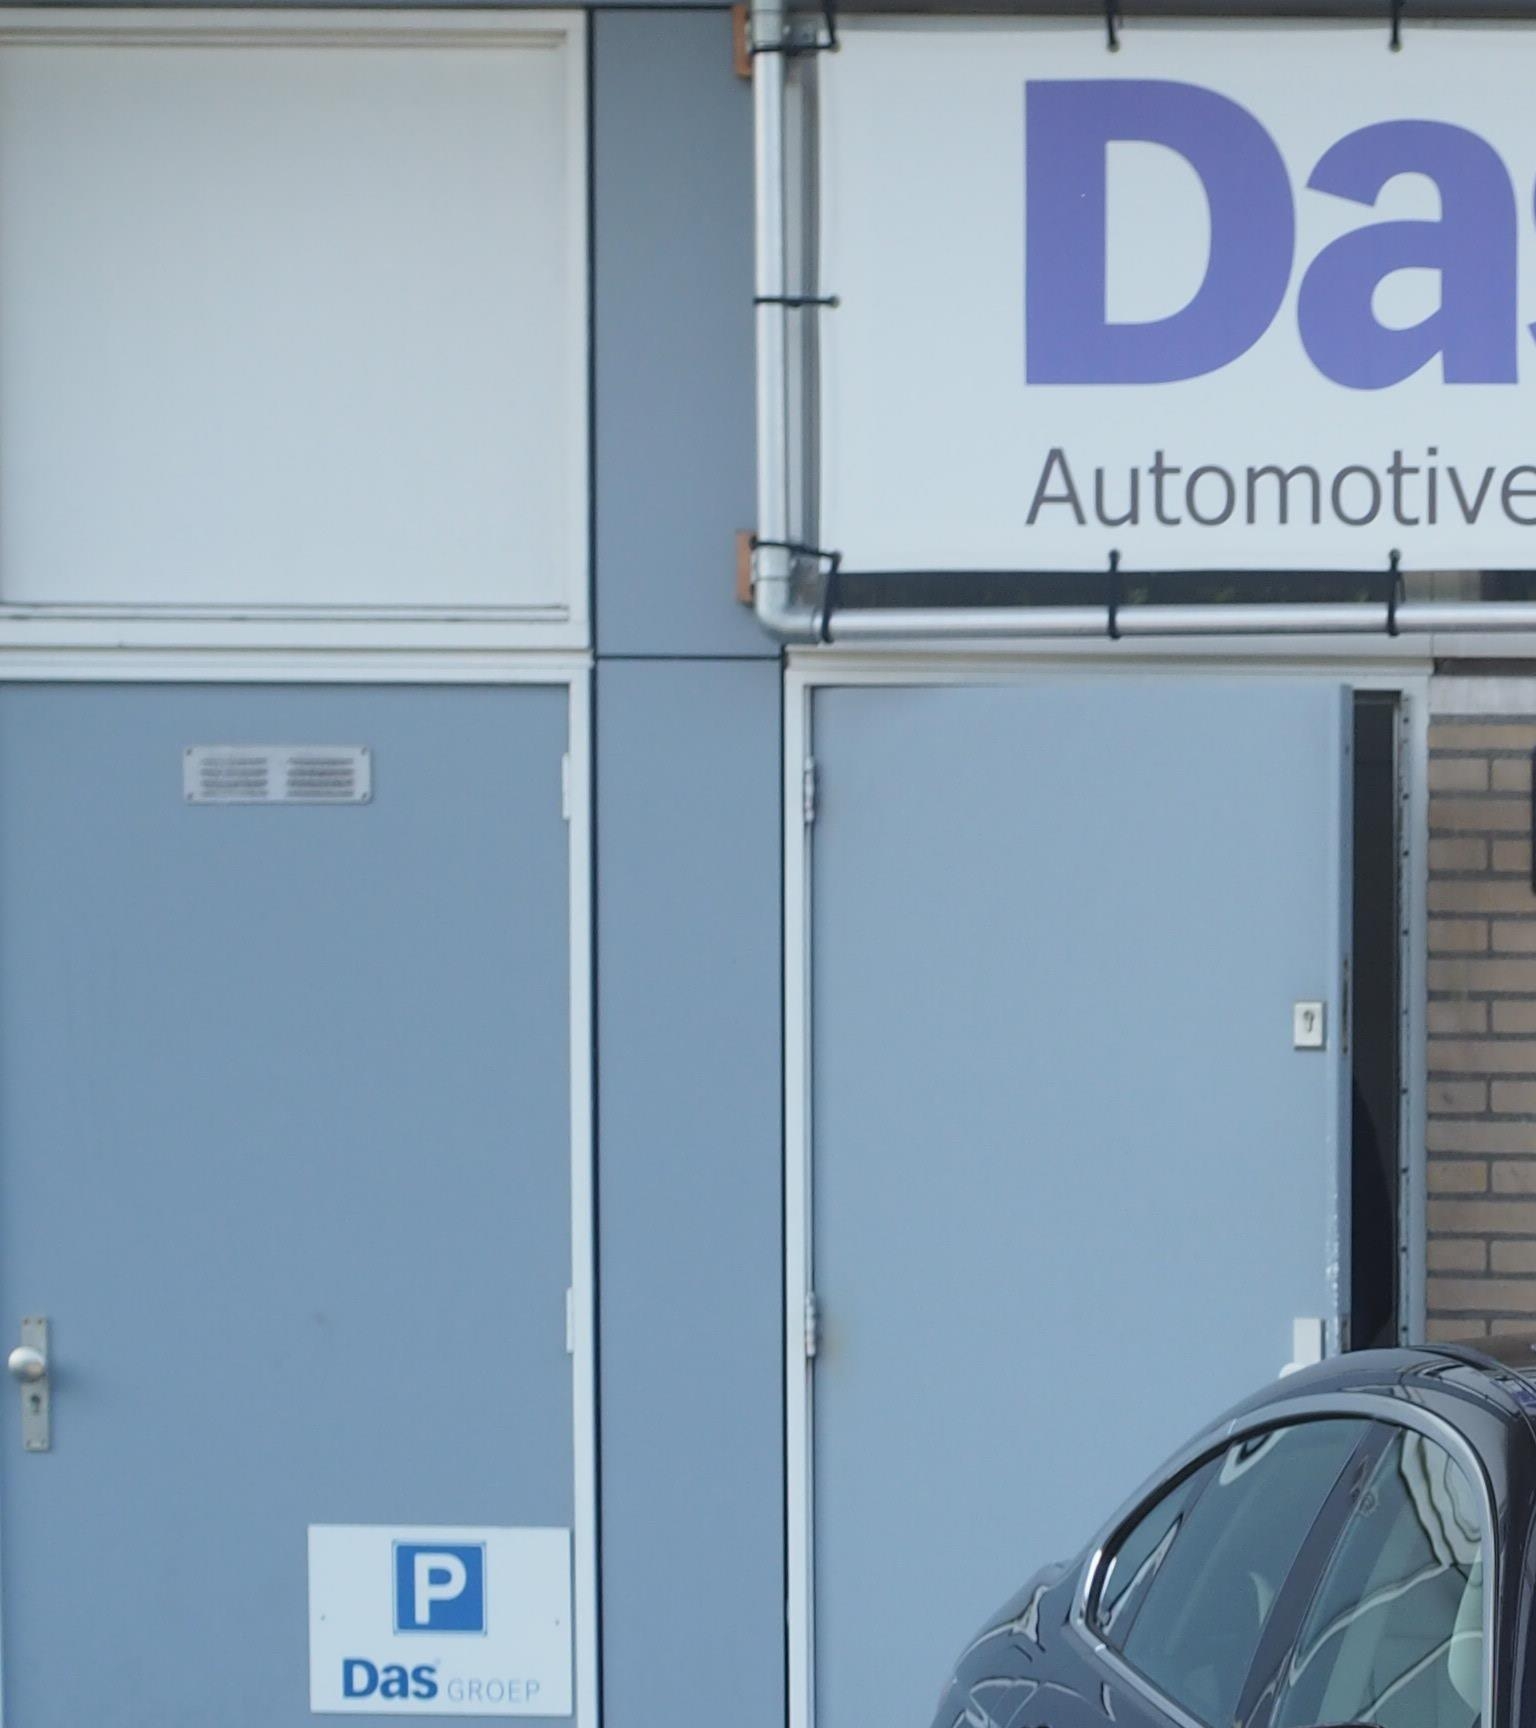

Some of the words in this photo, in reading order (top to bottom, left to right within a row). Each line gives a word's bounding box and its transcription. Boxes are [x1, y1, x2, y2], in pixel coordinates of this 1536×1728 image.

[414, 1552, 467, 1625] P
[342, 1657, 439, 1700] Das
[447, 1678, 541, 1703] GROEP
